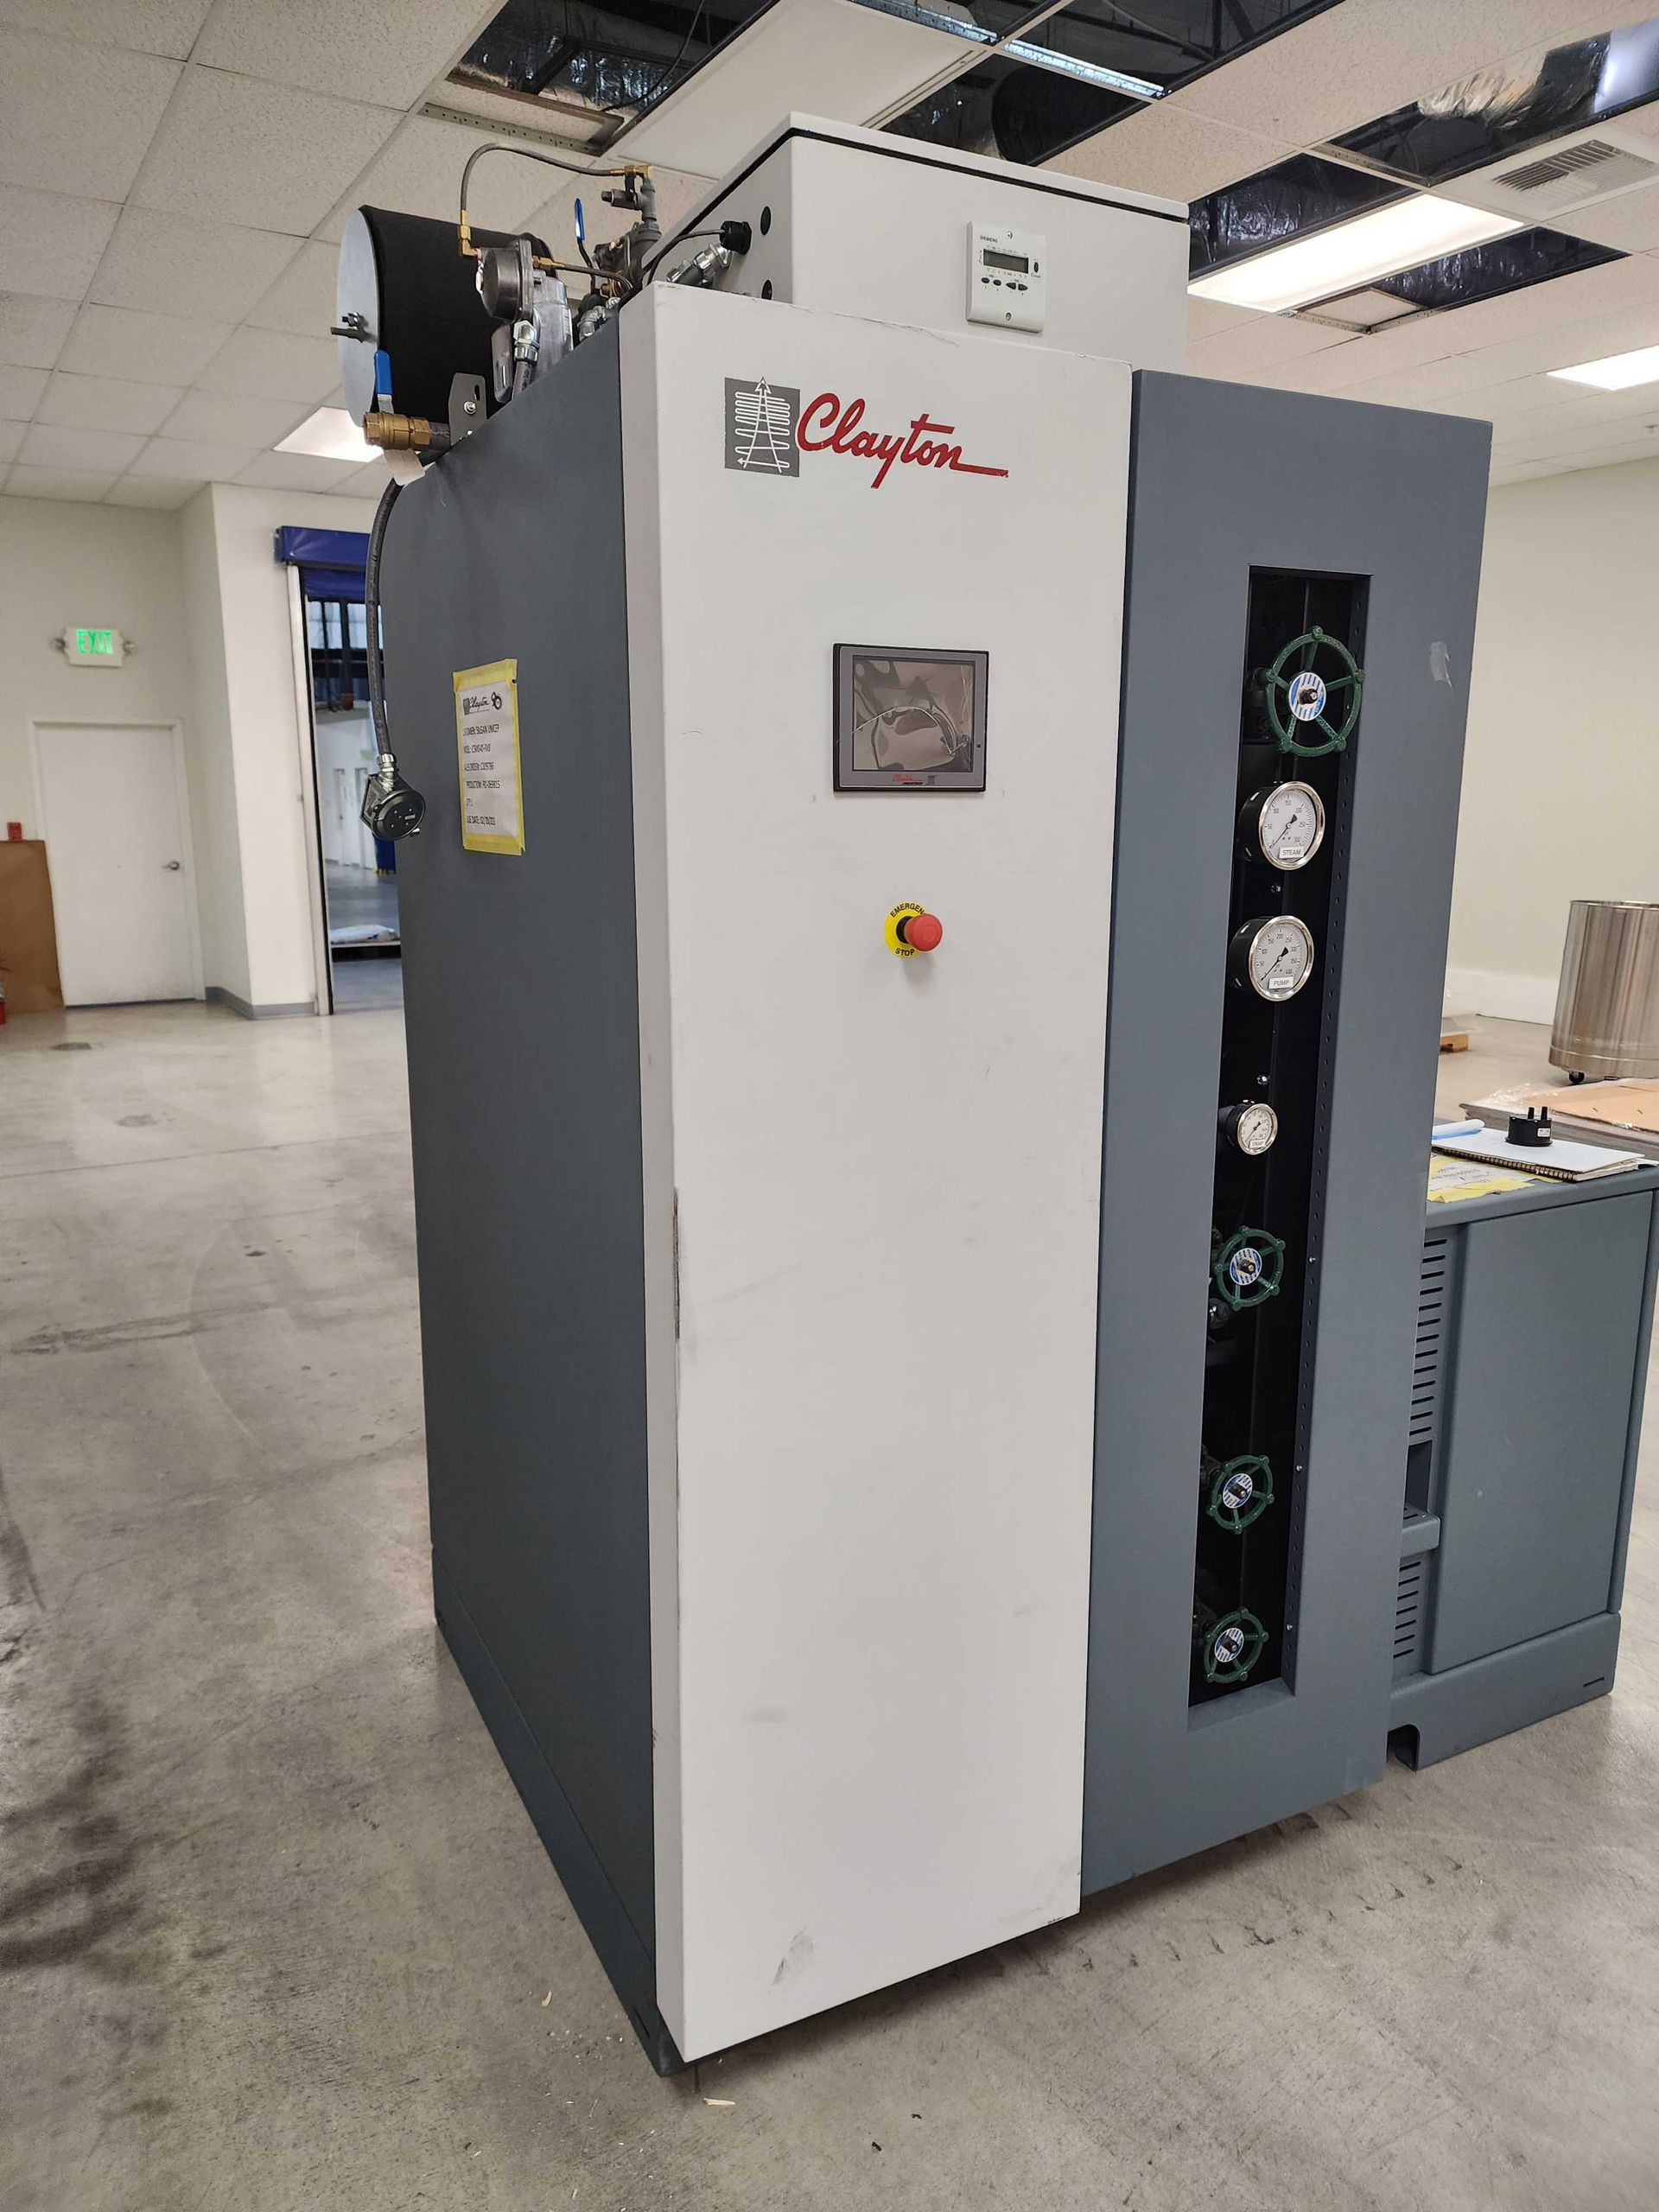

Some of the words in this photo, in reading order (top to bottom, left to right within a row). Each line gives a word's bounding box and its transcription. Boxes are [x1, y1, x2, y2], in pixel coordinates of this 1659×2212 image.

[797, 392, 1008, 489] Clayton
[76, 629, 112, 655] EXIT
[890, 902, 925, 918] EMERGEN
[895, 947, 915, 957] STOP
